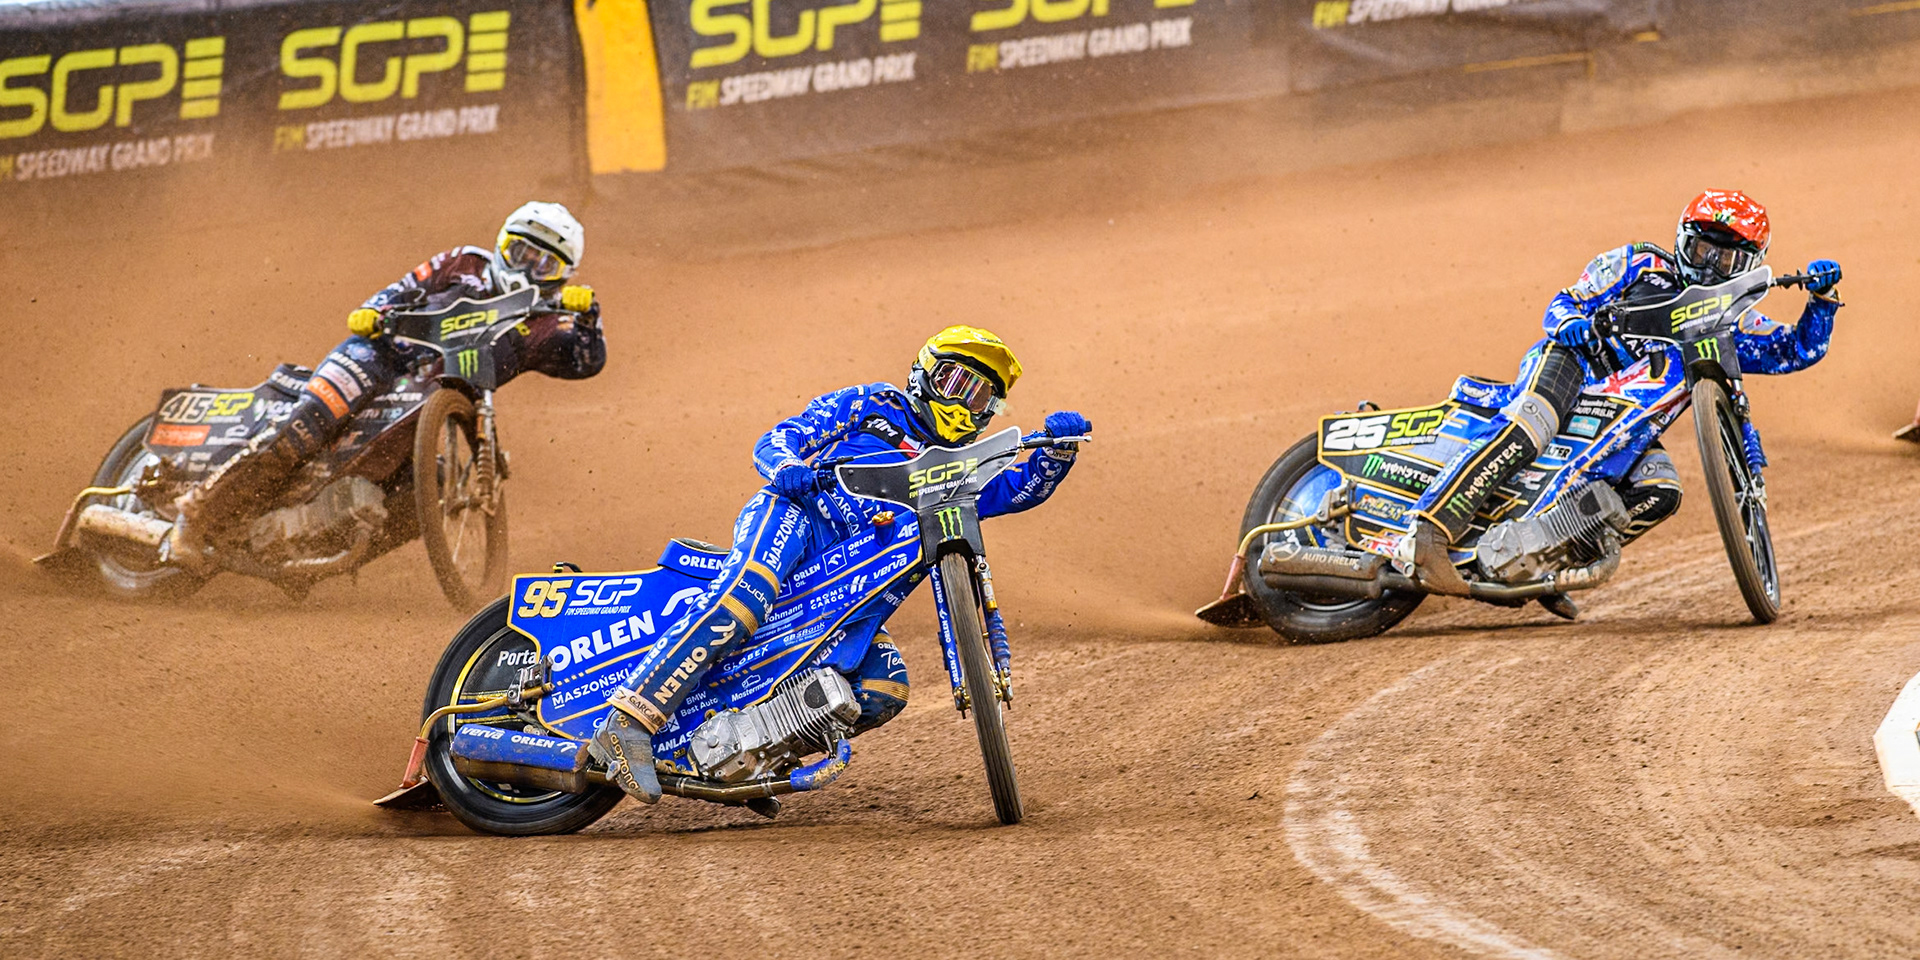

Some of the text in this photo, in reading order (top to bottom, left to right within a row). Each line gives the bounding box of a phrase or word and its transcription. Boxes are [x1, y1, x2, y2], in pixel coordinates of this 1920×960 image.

[999, 31, 1087, 71] SPEEDWAY
[1088, 23, 1150, 58] GRAND
[1150, 17, 1193, 48] PRIX
[720, 66, 811, 107] SPEEDWAY
[812, 58, 872, 91] GRAND
[873, 52, 918, 83] PRIX
[306, 114, 396, 151] SPEEDWAY
[397, 108, 458, 142] GRAND
[458, 104, 500, 137] PRIX
[15, 143, 110, 182] SPEEDWAY
[110, 136, 172, 171] GRAND
[1323, 409, 1445, 451] 25 SGP
[918, 483, 946, 496] SPEEDWAY
[847, 534, 875, 551] ORLEN
[849, 549, 861, 558] OIL
[679, 554, 724, 571] ORLEN
[1301, 552, 1327, 563] AUTO
[793, 563, 821, 582] ORLEN
[517, 577, 643, 618] 95 SGP
[811, 593, 845, 610] CARGO
[933, 580, 944, 604] ORLEN
[575, 606, 601, 616] SPEEDWAY
[601, 606, 618, 614] GRAND
[548, 610, 656, 672] ORLEN
[941, 620, 952, 644] ORLEN
[653, 646, 708, 705] ORLEN
[949, 659, 960, 683] ORLEN
[551, 668, 631, 709] MASZOŃSKI
[685, 691, 707, 706] BMW
[731, 677, 774, 702] Mastermedia
[680, 697, 719, 717] Best Auto
[617, 714, 631, 729] 95
[511, 734, 556, 749] ORLEN
[610, 734, 640, 791] daytona
